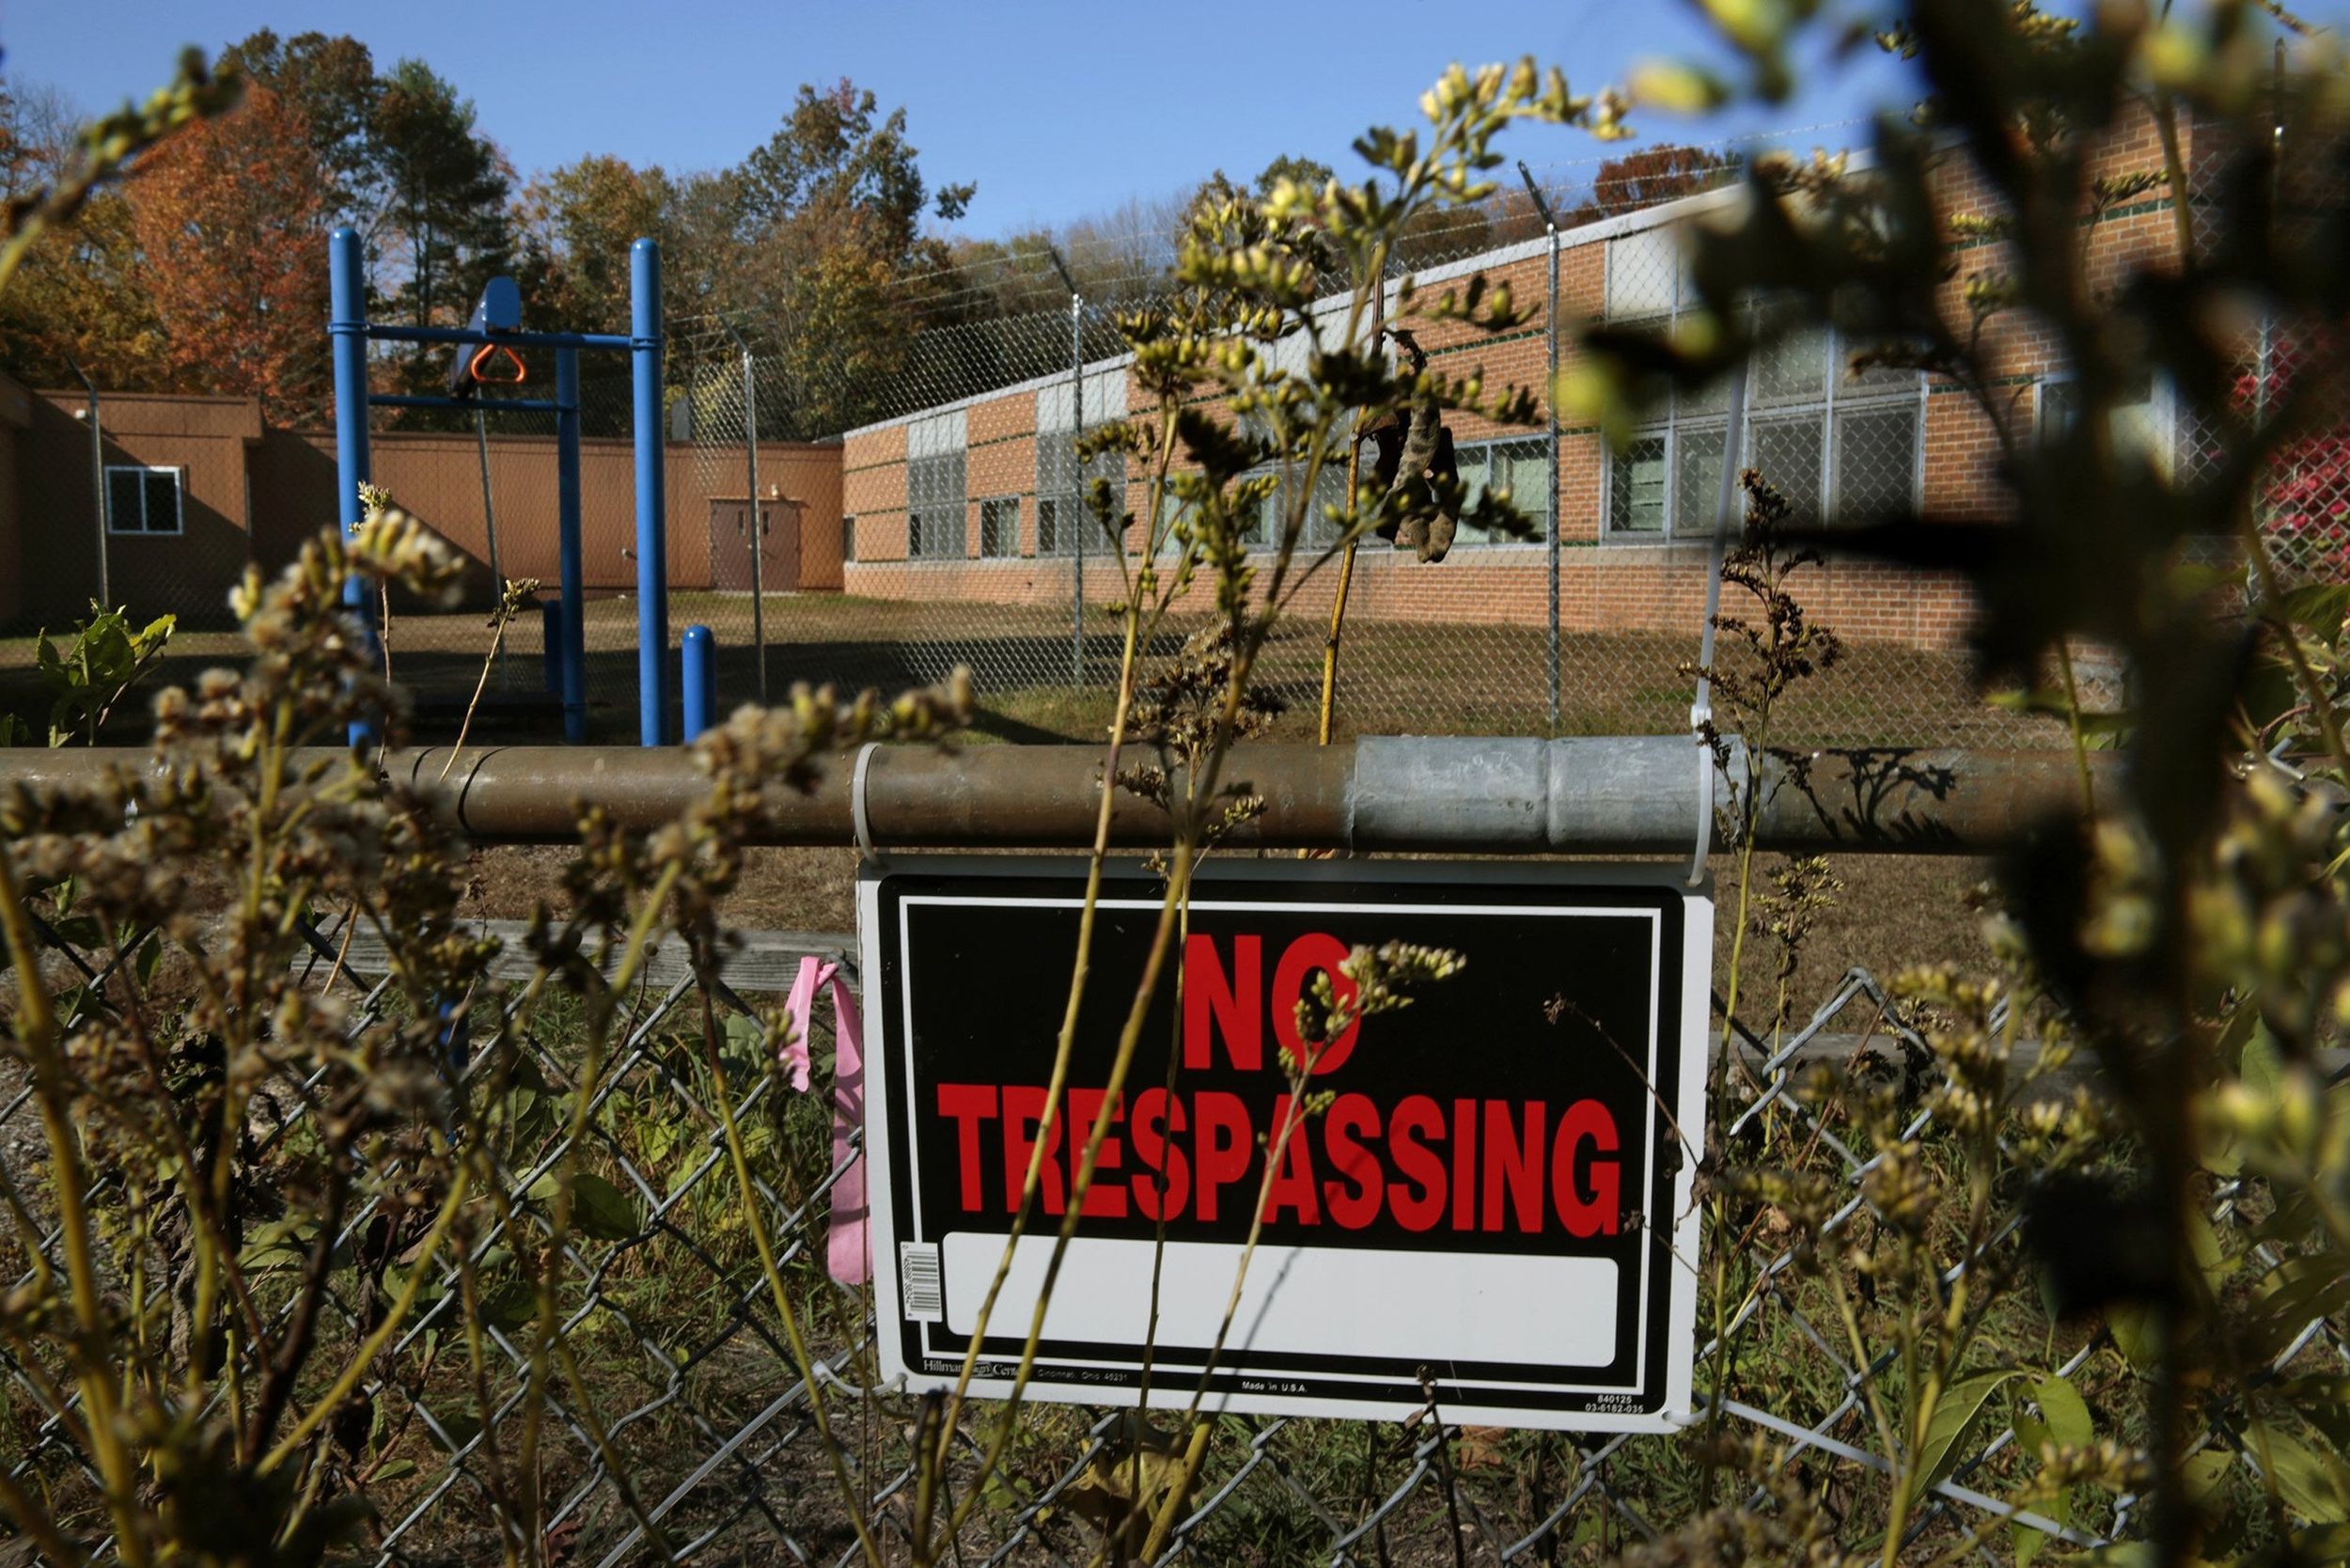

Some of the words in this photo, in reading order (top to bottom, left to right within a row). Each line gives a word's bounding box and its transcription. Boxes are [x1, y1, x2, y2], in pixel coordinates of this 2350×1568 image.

[1183, 933, 1360, 1075] NO
[937, 1084, 1620, 1238] TRESPASSING
[993, 1364, 1019, 1376] Cent
[1242, 1381, 1264, 1391] Made
[1268, 1382, 1277, 1391] in
[1281, 1384, 1308, 1393] U.S.A.
[1597, 1394, 1632, 1404] 840125
[1585, 1403, 1643, 1414] 03-6182-035
